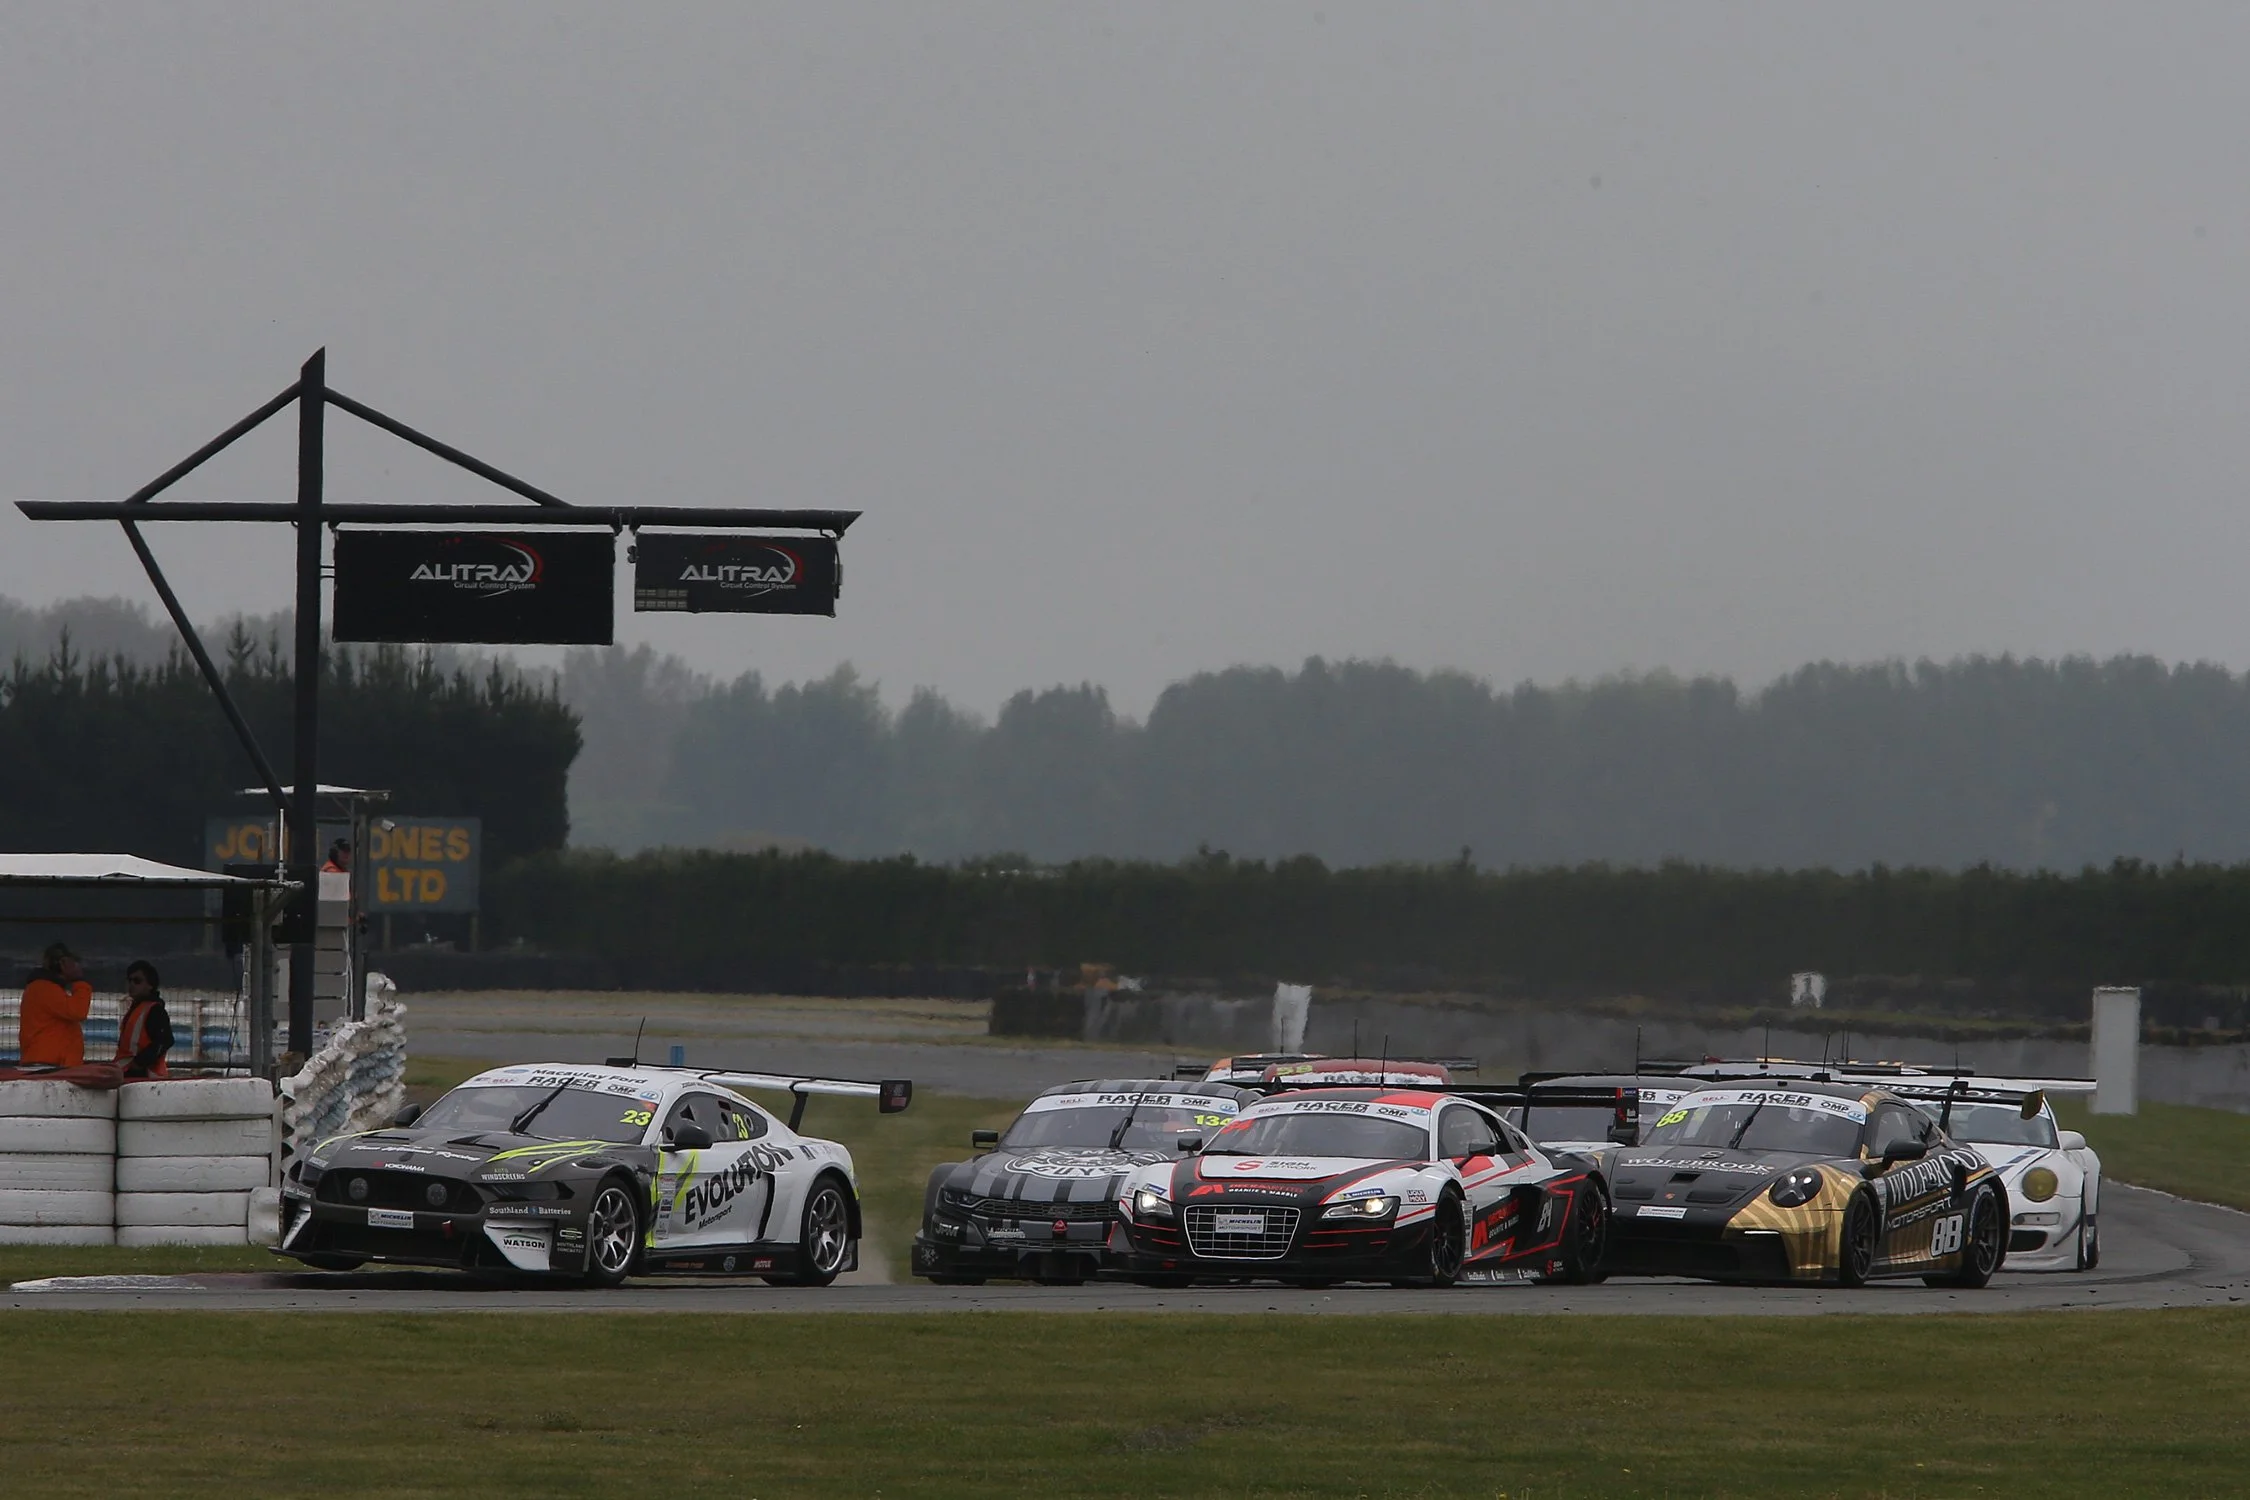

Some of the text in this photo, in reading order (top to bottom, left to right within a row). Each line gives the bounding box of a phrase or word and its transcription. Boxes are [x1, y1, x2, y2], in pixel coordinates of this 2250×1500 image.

[453, 581, 536, 591] Circuit Control System
[770, 582, 797, 590] System
[369, 825, 471, 861] ONES
[378, 866, 447, 904] LTD
[531, 1068, 649, 1084] Macaulay Ford
[607, 1084, 639, 1094] OMP
[1096, 1094, 1173, 1105] RACER
[1181, 1097, 1212, 1106] OMP
[1738, 1092, 1812, 1105] RACER
[1820, 1100, 1848, 1112] OMP
[619, 1109, 652, 1126] 23
[1293, 1102, 1370, 1112] RACER
[1378, 1108, 1408, 1117] OMP
[732, 1112, 750, 1140] 23
[1656, 1110, 1689, 1128] 88
[384, 1162, 425, 1172] YOKOHAMA
[685, 1143, 795, 1225] EVOLUTION
[1269, 1190, 1299, 1199] MARBLE
[1351, 1189, 1382, 1198] MICHELIN
[489, 1206, 572, 1216] Southland Batteries
[698, 1205, 733, 1230] Motorsport
[1887, 1195, 1952, 1230] MOTORSPORT
[503, 1238, 545, 1249] WATSON
[1931, 1214, 1964, 1257] 88
